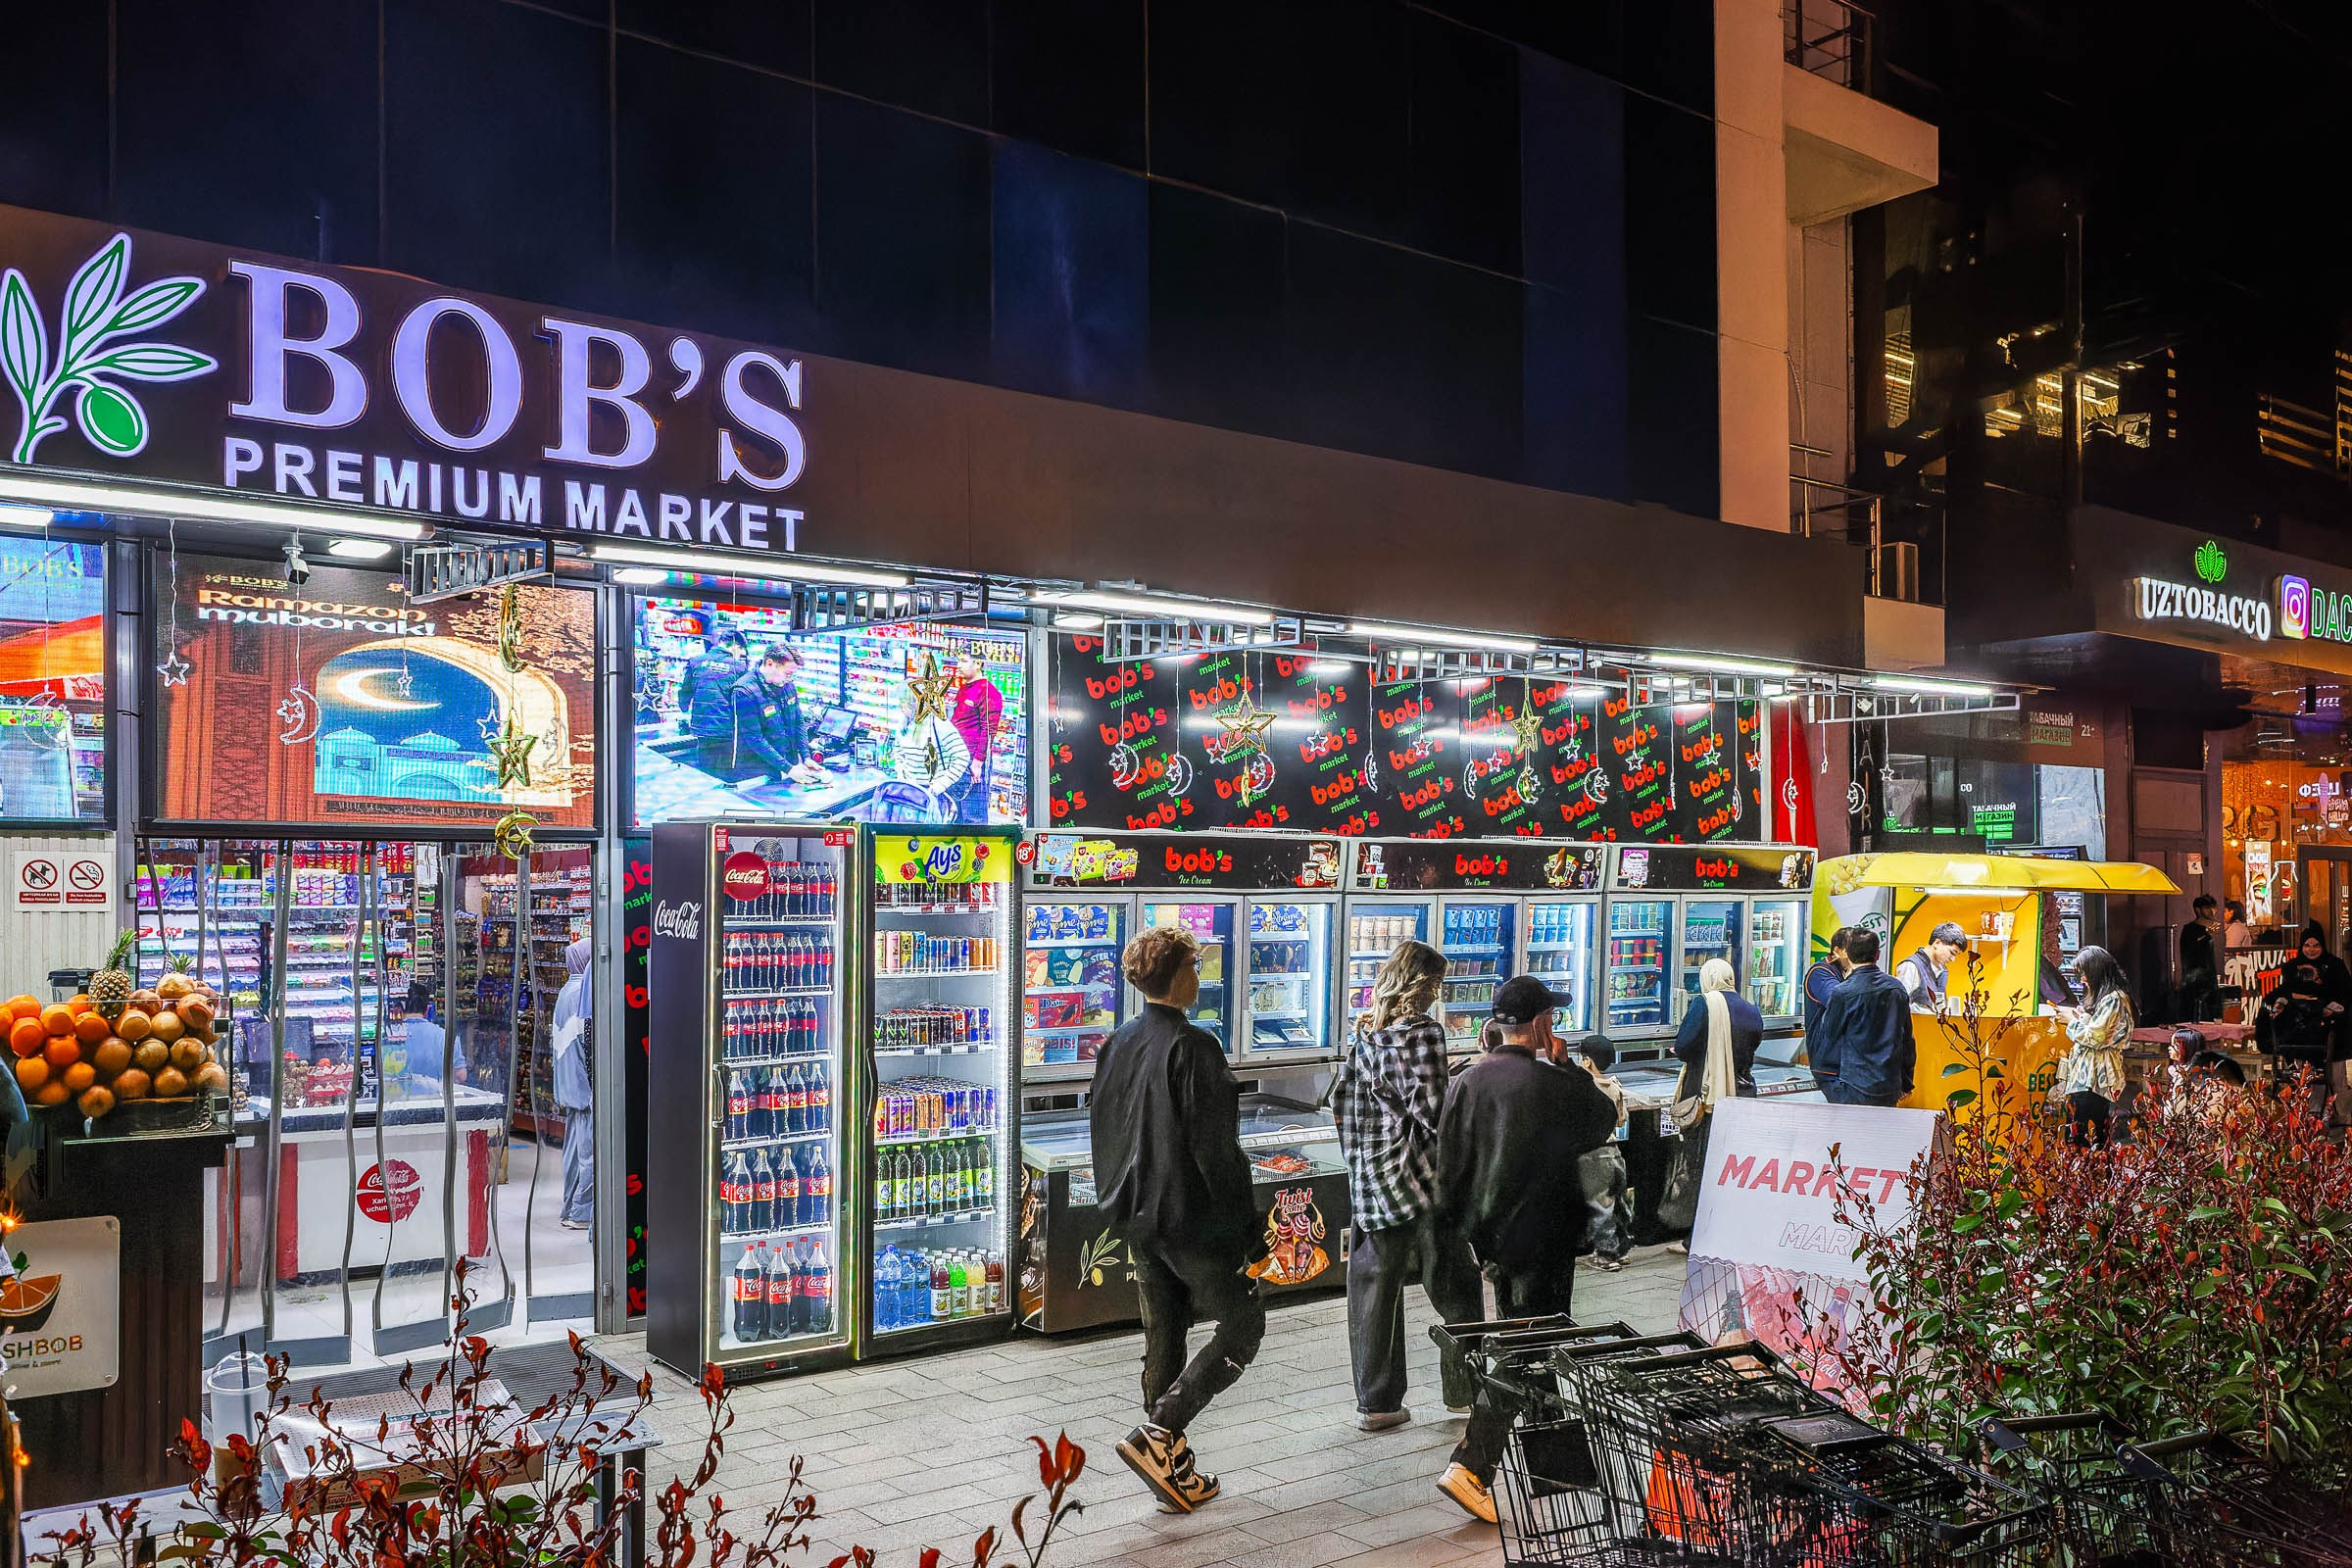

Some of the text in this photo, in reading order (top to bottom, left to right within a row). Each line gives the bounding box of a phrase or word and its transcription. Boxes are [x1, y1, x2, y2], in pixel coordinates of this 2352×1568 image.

[227, 258, 807, 491] BOB'S
[224, 436, 806, 552] PREMIUM MARKET
[229, 575, 288, 587] BOB'S
[198, 589, 427, 622] Ramazon
[2139, 576, 2272, 642] UZTOBACCO
[198, 607, 436, 636] muborak!
[1199, 657, 1231, 676] market
[1085, 662, 1155, 700] bob's
[1189, 673, 1254, 710] bob's
[1109, 689, 1145, 710] market
[1288, 684, 1348, 719] bob's
[1470, 690, 1496, 708] market
[1378, 695, 1435, 729] bob's
[1619, 710, 1643, 725] market
[1099, 707, 1168, 746] bob's
[1541, 714, 1591, 746] bob's
[1687, 717, 1709, 734] market
[1123, 735, 1158, 754] market
[1613, 723, 1659, 755] bob's
[1681, 732, 1724, 762] bob's
[1224, 746, 1256, 764] market
[1319, 753, 1349, 772] market
[1407, 760, 1436, 779] market
[1491, 767, 1517, 785] market
[1550, 753, 1598, 784] bob's
[1621, 760, 1666, 792] bob's
[1137, 780, 1171, 801] market
[1310, 769, 1367, 806] bob's
[1637, 782, 1659, 799] market
[1689, 767, 1732, 798] bob's
[1236, 791, 1268, 808] mrket
[1330, 794, 1361, 813] market
[1399, 776, 1454, 811] bob's
[1702, 788, 1725, 806] market
[1418, 800, 1446, 819] market
[1499, 807, 1526, 824] market
[1631, 797, 1673, 828] bob's
[1697, 804, 1737, 835] bob's
[1975, 812, 2013, 821] МГАЗИН
[1577, 812, 1600, 829] market
[1644, 819, 1668, 835] market
[1711, 825, 1733, 841] market
[924, 844, 961, 876] Ays
[950, 863, 960, 873] Tea
[1165, 846, 1233, 872] bob's
[1455, 855, 1508, 876] bob's
[1695, 857, 1739, 878] bob's
[725, 869, 766, 885] Coca-Cola
[1178, 874, 1211, 885] Ice Cream
[654, 900, 703, 940] Coca-Cola
[1854, 916, 1882, 929] EST
[2029, 1073, 2056, 1092] BES
[1717, 1153, 1908, 1204] MARKET
[1275, 1188, 1313, 1208] Twist
[1779, 1222, 1861, 1256] MAR
